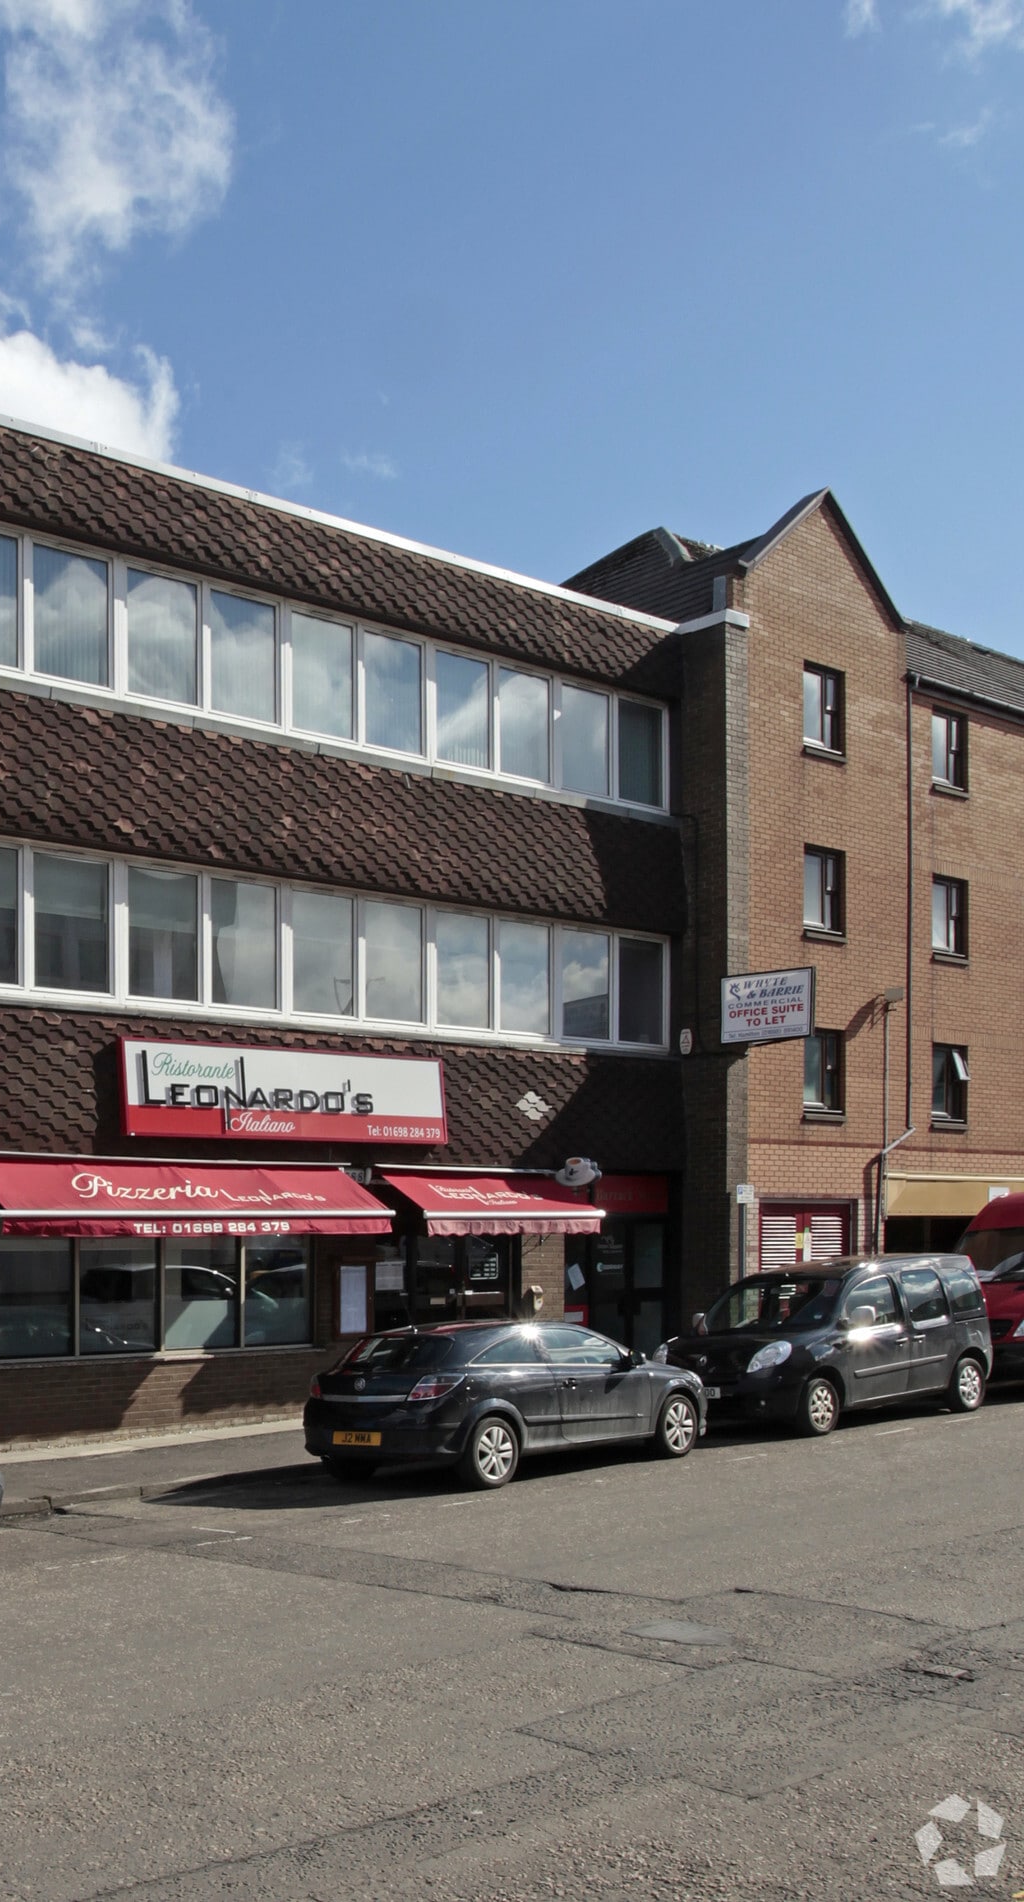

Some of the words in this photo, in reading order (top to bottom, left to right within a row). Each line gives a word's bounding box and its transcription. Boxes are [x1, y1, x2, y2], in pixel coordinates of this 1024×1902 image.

[744, 976, 787, 989] WHYTE
[747, 990, 756, 999] &
[759, 985, 804, 999] BARRIE
[728, 997, 802, 1010] COMMERCIAL
[729, 1007, 767, 1019] OFFICE
[772, 1003, 804, 1015] SUITE
[746, 1018, 761, 1027] TO
[765, 1015, 786, 1025] LET
[151, 1052, 236, 1079] Ristorante
[230, 1111, 295, 1133] Italiano
[367, 1125, 382, 1136] Tel:
[383, 1126, 408, 1137] 01698
[410, 1127, 424, 1138] 284
[426, 1128, 441, 1139] 379
[71, 1173, 218, 1199] Pizzeria
[134, 1223, 166, 1233] TEL:
[172, 1222, 223, 1234] 01698
[228, 1221, 256, 1232] 284
[262, 1221, 290, 1231] 379
